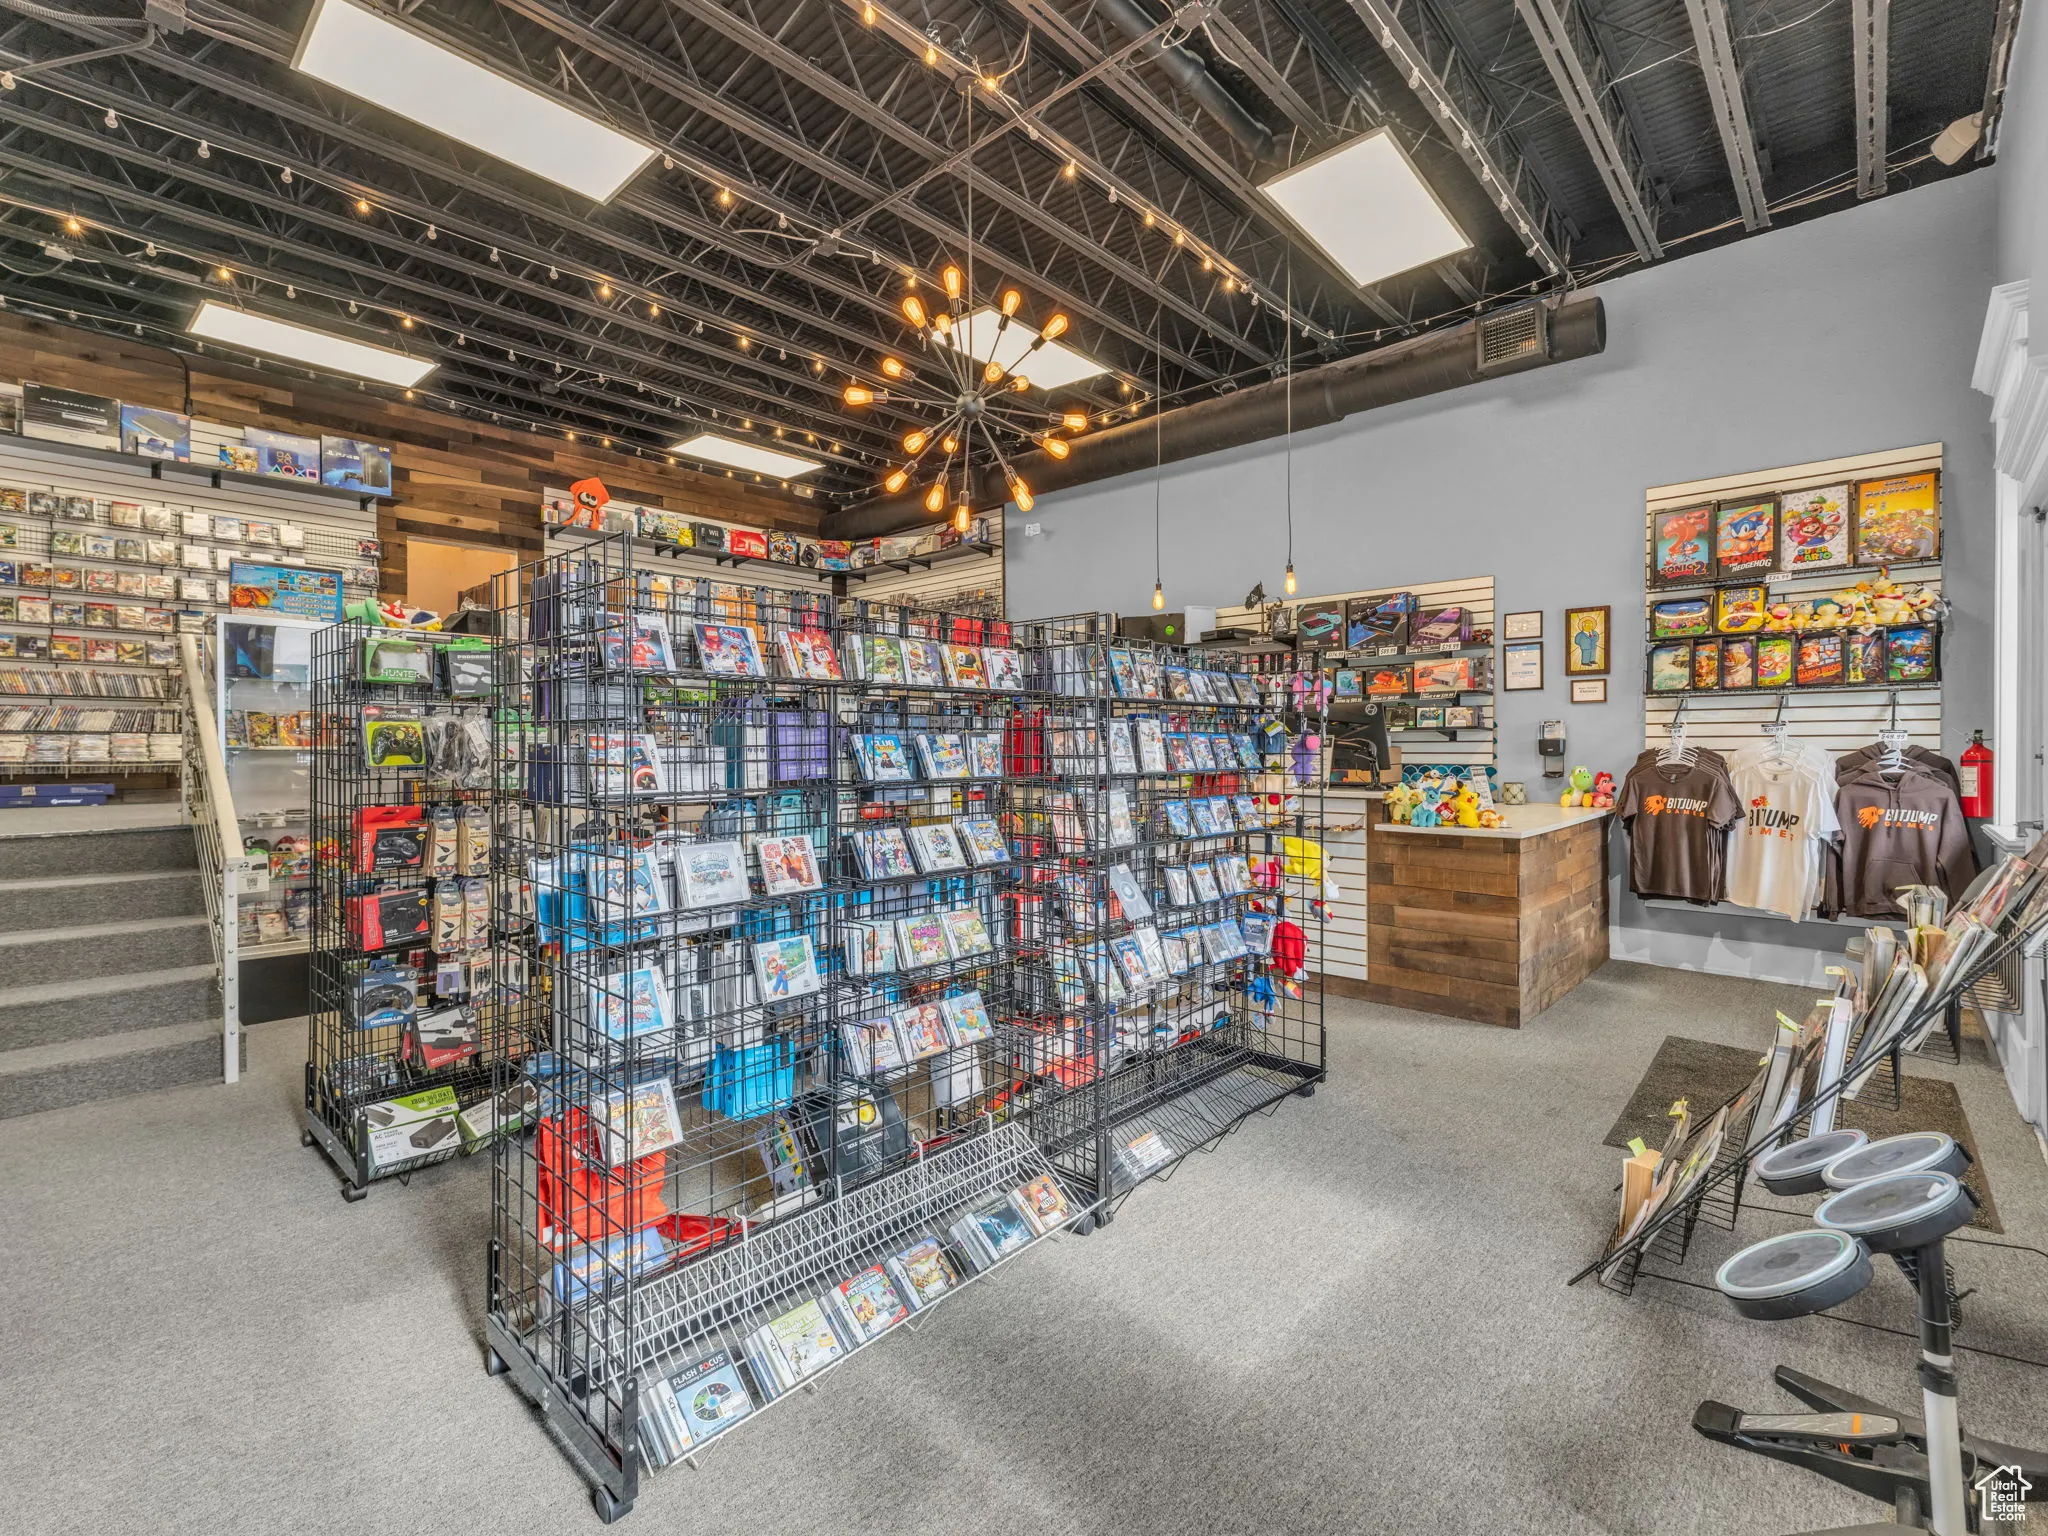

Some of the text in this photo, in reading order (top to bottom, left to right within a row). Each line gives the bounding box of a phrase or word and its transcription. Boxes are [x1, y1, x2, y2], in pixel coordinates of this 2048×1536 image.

[708, 529, 719, 537] Wii
[1721, 551, 1768, 567] SONIC
[1793, 551, 1833, 563] MARIO
[1660, 560, 1707, 575] SONIC 2
[1732, 559, 1772, 572] HEDGEHOG
[1749, 589, 1760, 602] 3
[1666, 797, 1708, 812] BITJUMP
[1666, 809, 1705, 817] GAMES
[1884, 809, 1939, 825] BITJUMP
[672, 1369, 697, 1386] FLASH
[700, 1354, 724, 1372] FOCUS
